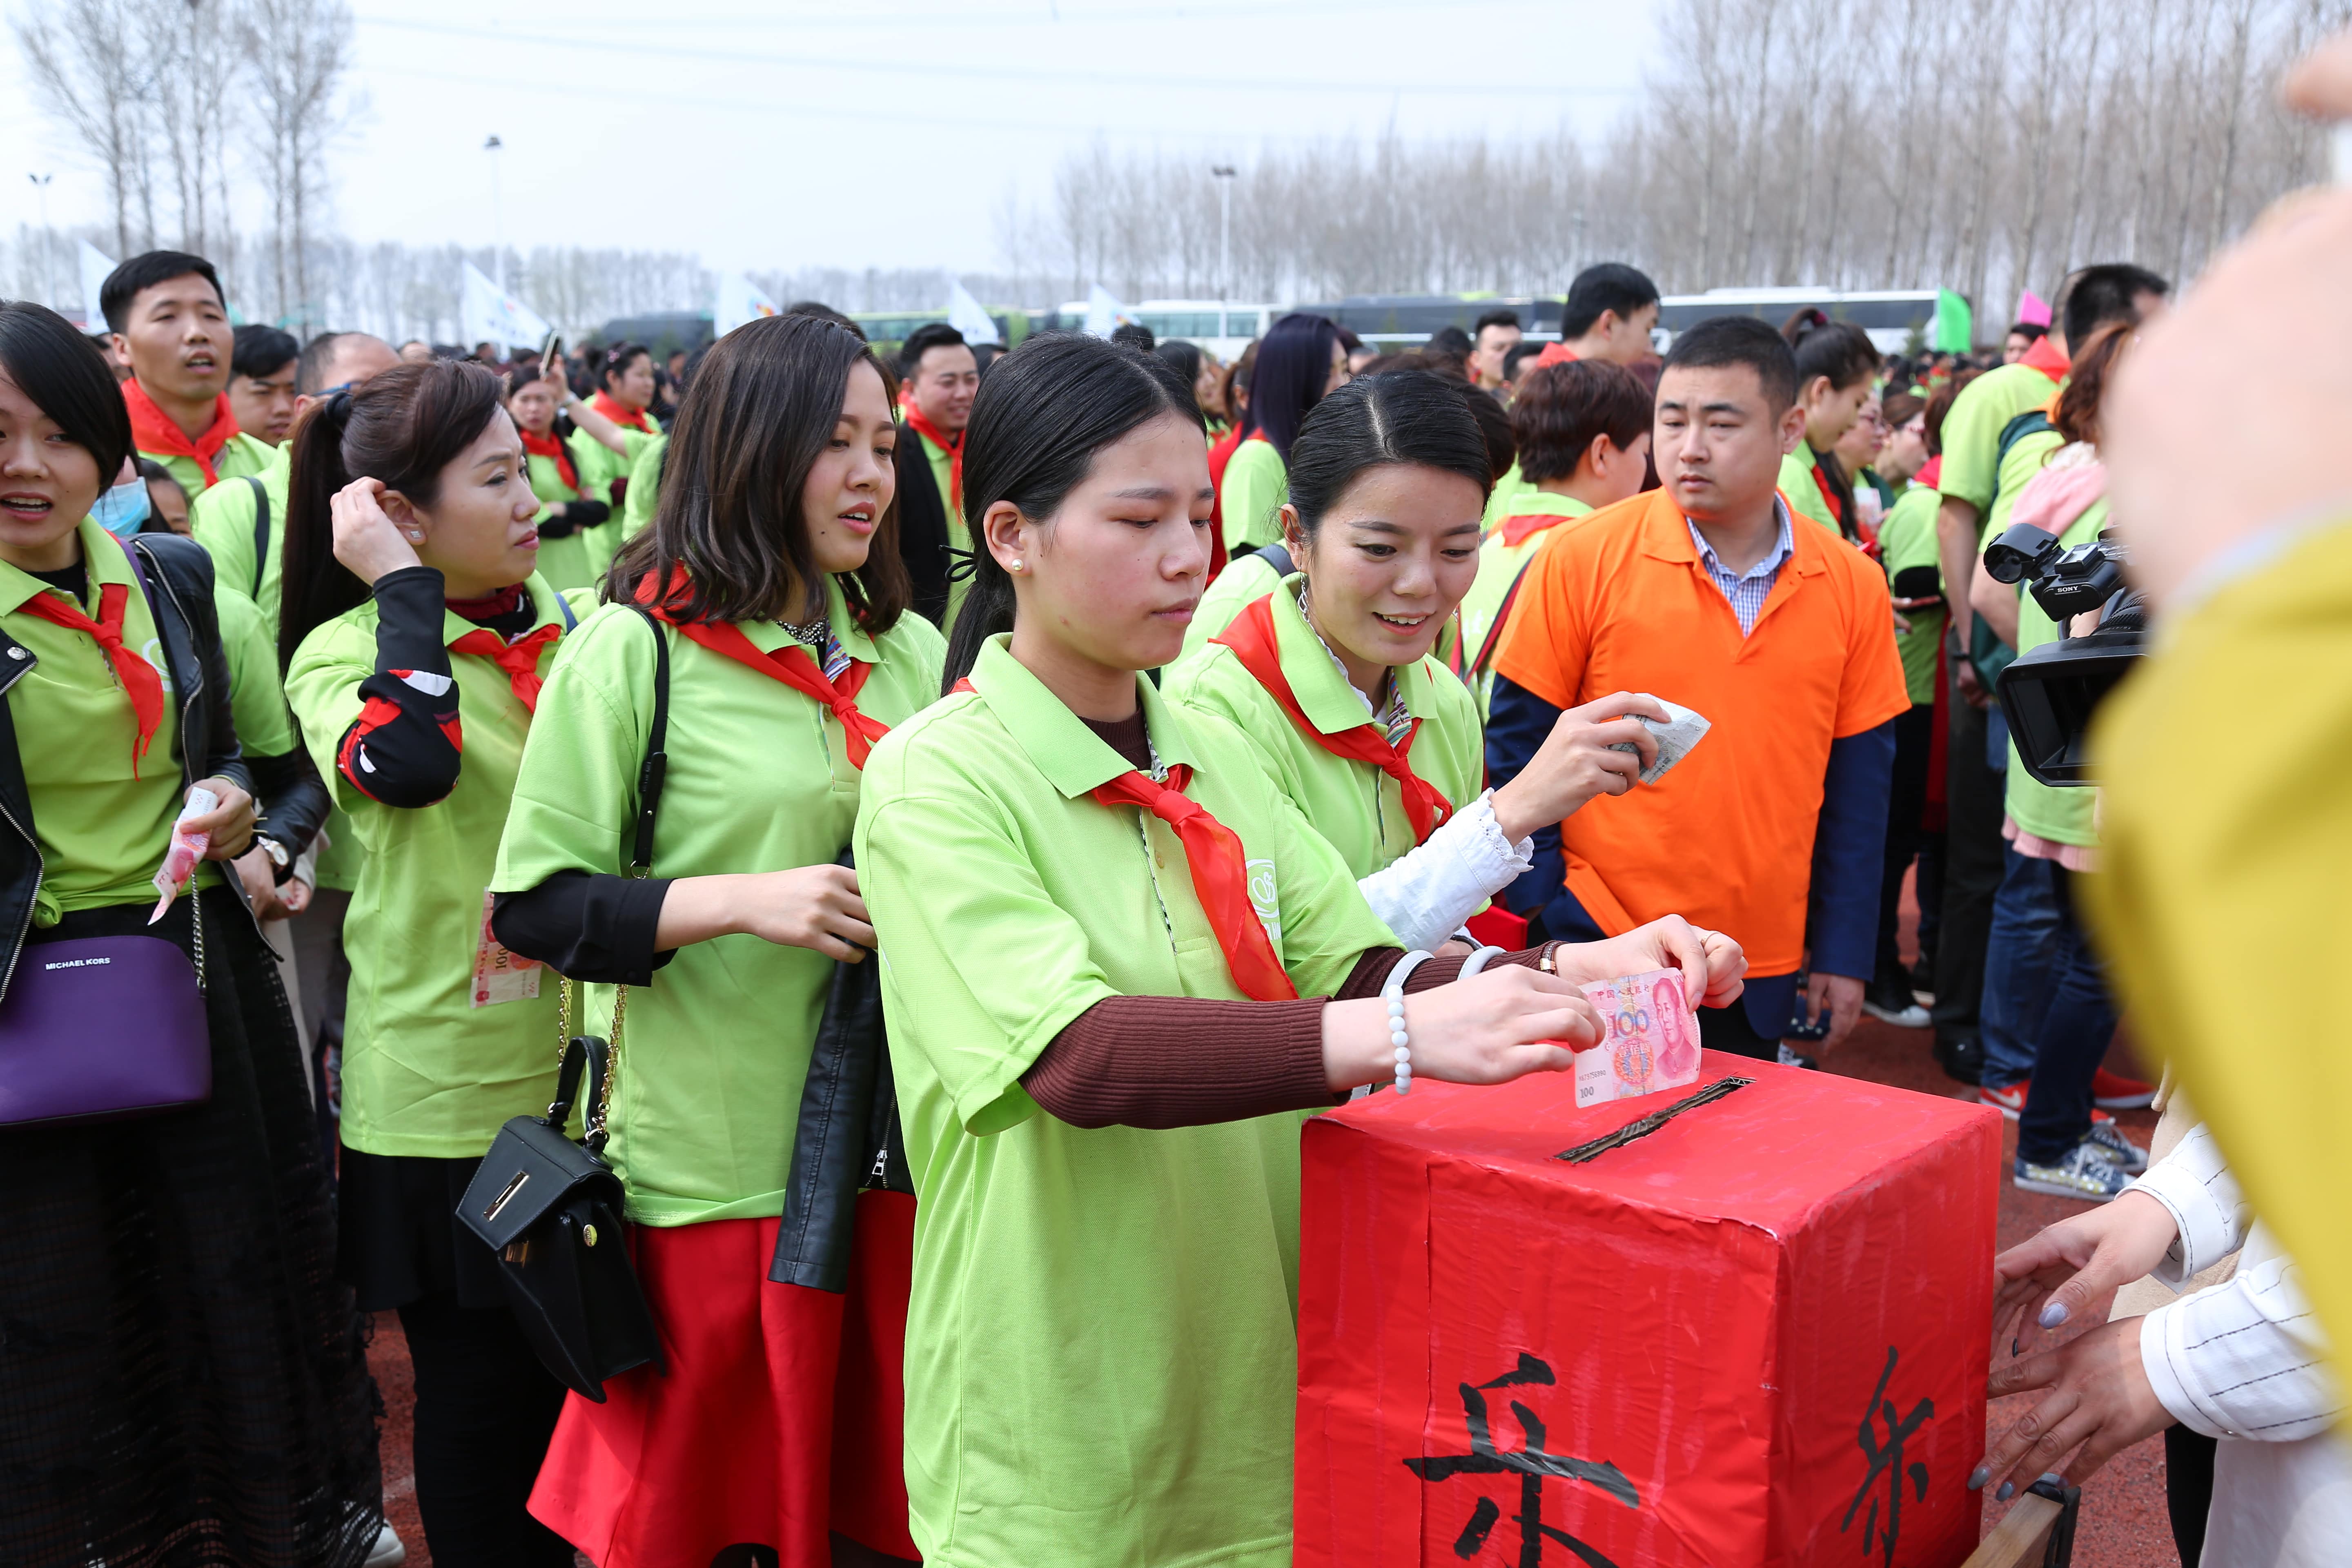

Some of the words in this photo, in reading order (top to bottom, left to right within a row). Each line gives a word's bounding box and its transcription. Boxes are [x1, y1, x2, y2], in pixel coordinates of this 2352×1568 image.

[45, 960, 85, 970] MICHAEL
[85, 957, 111, 965] KORS
[1608, 1009, 1650, 1037] 100
[1580, 1086, 1595, 1098] 100
